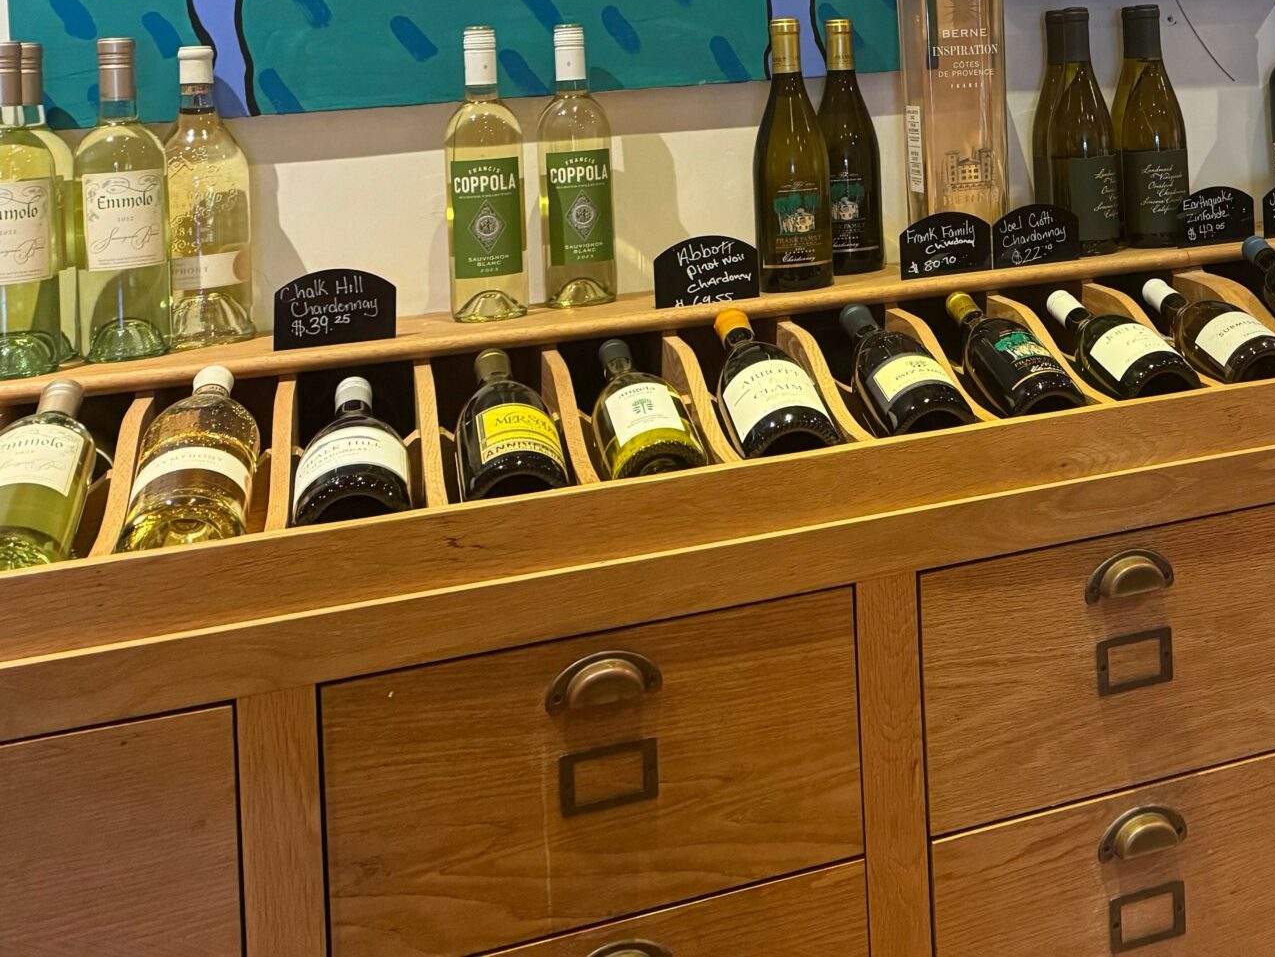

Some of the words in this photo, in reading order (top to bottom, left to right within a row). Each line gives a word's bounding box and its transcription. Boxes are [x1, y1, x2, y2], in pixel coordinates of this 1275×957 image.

[942, 27, 988, 38] BERNE
[932, 43, 999, 57] INSPIRATION
[938, 70, 949, 78] DE
[952, 68, 995, 77] PROVENCE
[953, 59, 980, 69] CÔTES
[468, 165, 501, 175] FRANCIS
[564, 156, 596, 166] FRANCIS
[550, 163, 608, 184] COPPOLA
[454, 173, 517, 194] COPPOLA
[97, 193, 153, 211] Emmolo
[1182, 190, 1234, 211] Earthquake
[906, 227, 939, 245] Frank
[942, 219, 976, 241] Family
[1000, 215, 1024, 234] Joel
[1002, 225, 1067, 248] Chardonnay
[564, 242, 604, 250] SAUVIGNON
[677, 240, 735, 267] Abbott
[468, 254, 510, 263] SAUVIGNON
[280, 279, 329, 302] Chalk
[335, 275, 363, 295] Hill
[290, 297, 379, 318] Chardonnay
